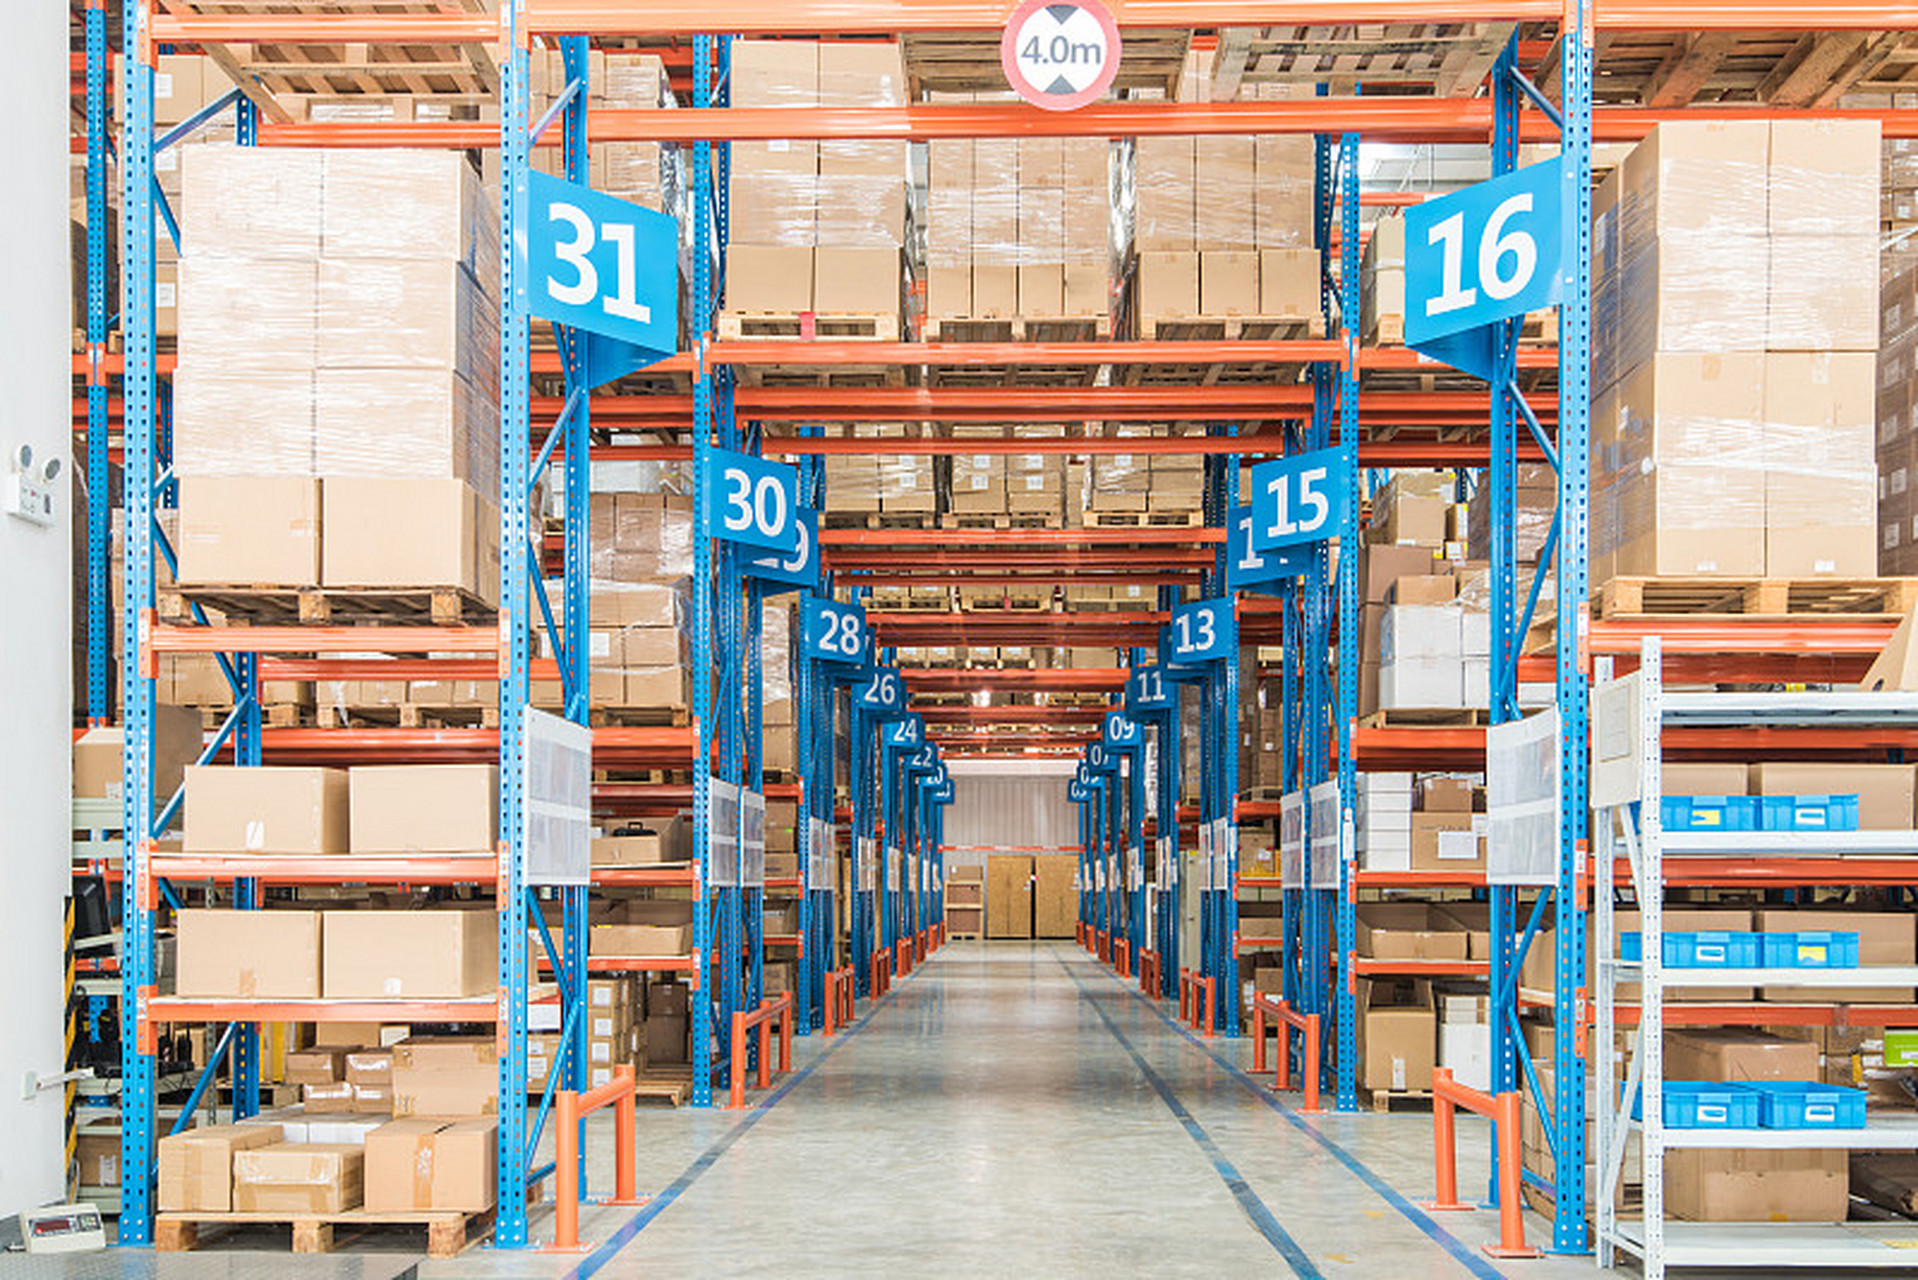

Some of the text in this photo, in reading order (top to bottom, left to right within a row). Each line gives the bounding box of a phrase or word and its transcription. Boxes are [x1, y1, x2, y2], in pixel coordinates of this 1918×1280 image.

[1021, 35, 1101, 65] 4.0m
[547, 203, 651, 324] 31
[1426, 192, 1537, 316] 16
[723, 468, 787, 537] 30
[1267, 467, 1329, 538] 15
[752, 518, 809, 572] 9
[818, 609, 860, 655] 28
[1175, 608, 1216, 653] 13
[864, 673, 895, 705] 26
[1137, 670, 1166, 702] 11
[894, 718, 917, 743] 24
[1110, 715, 1135, 741] 09
